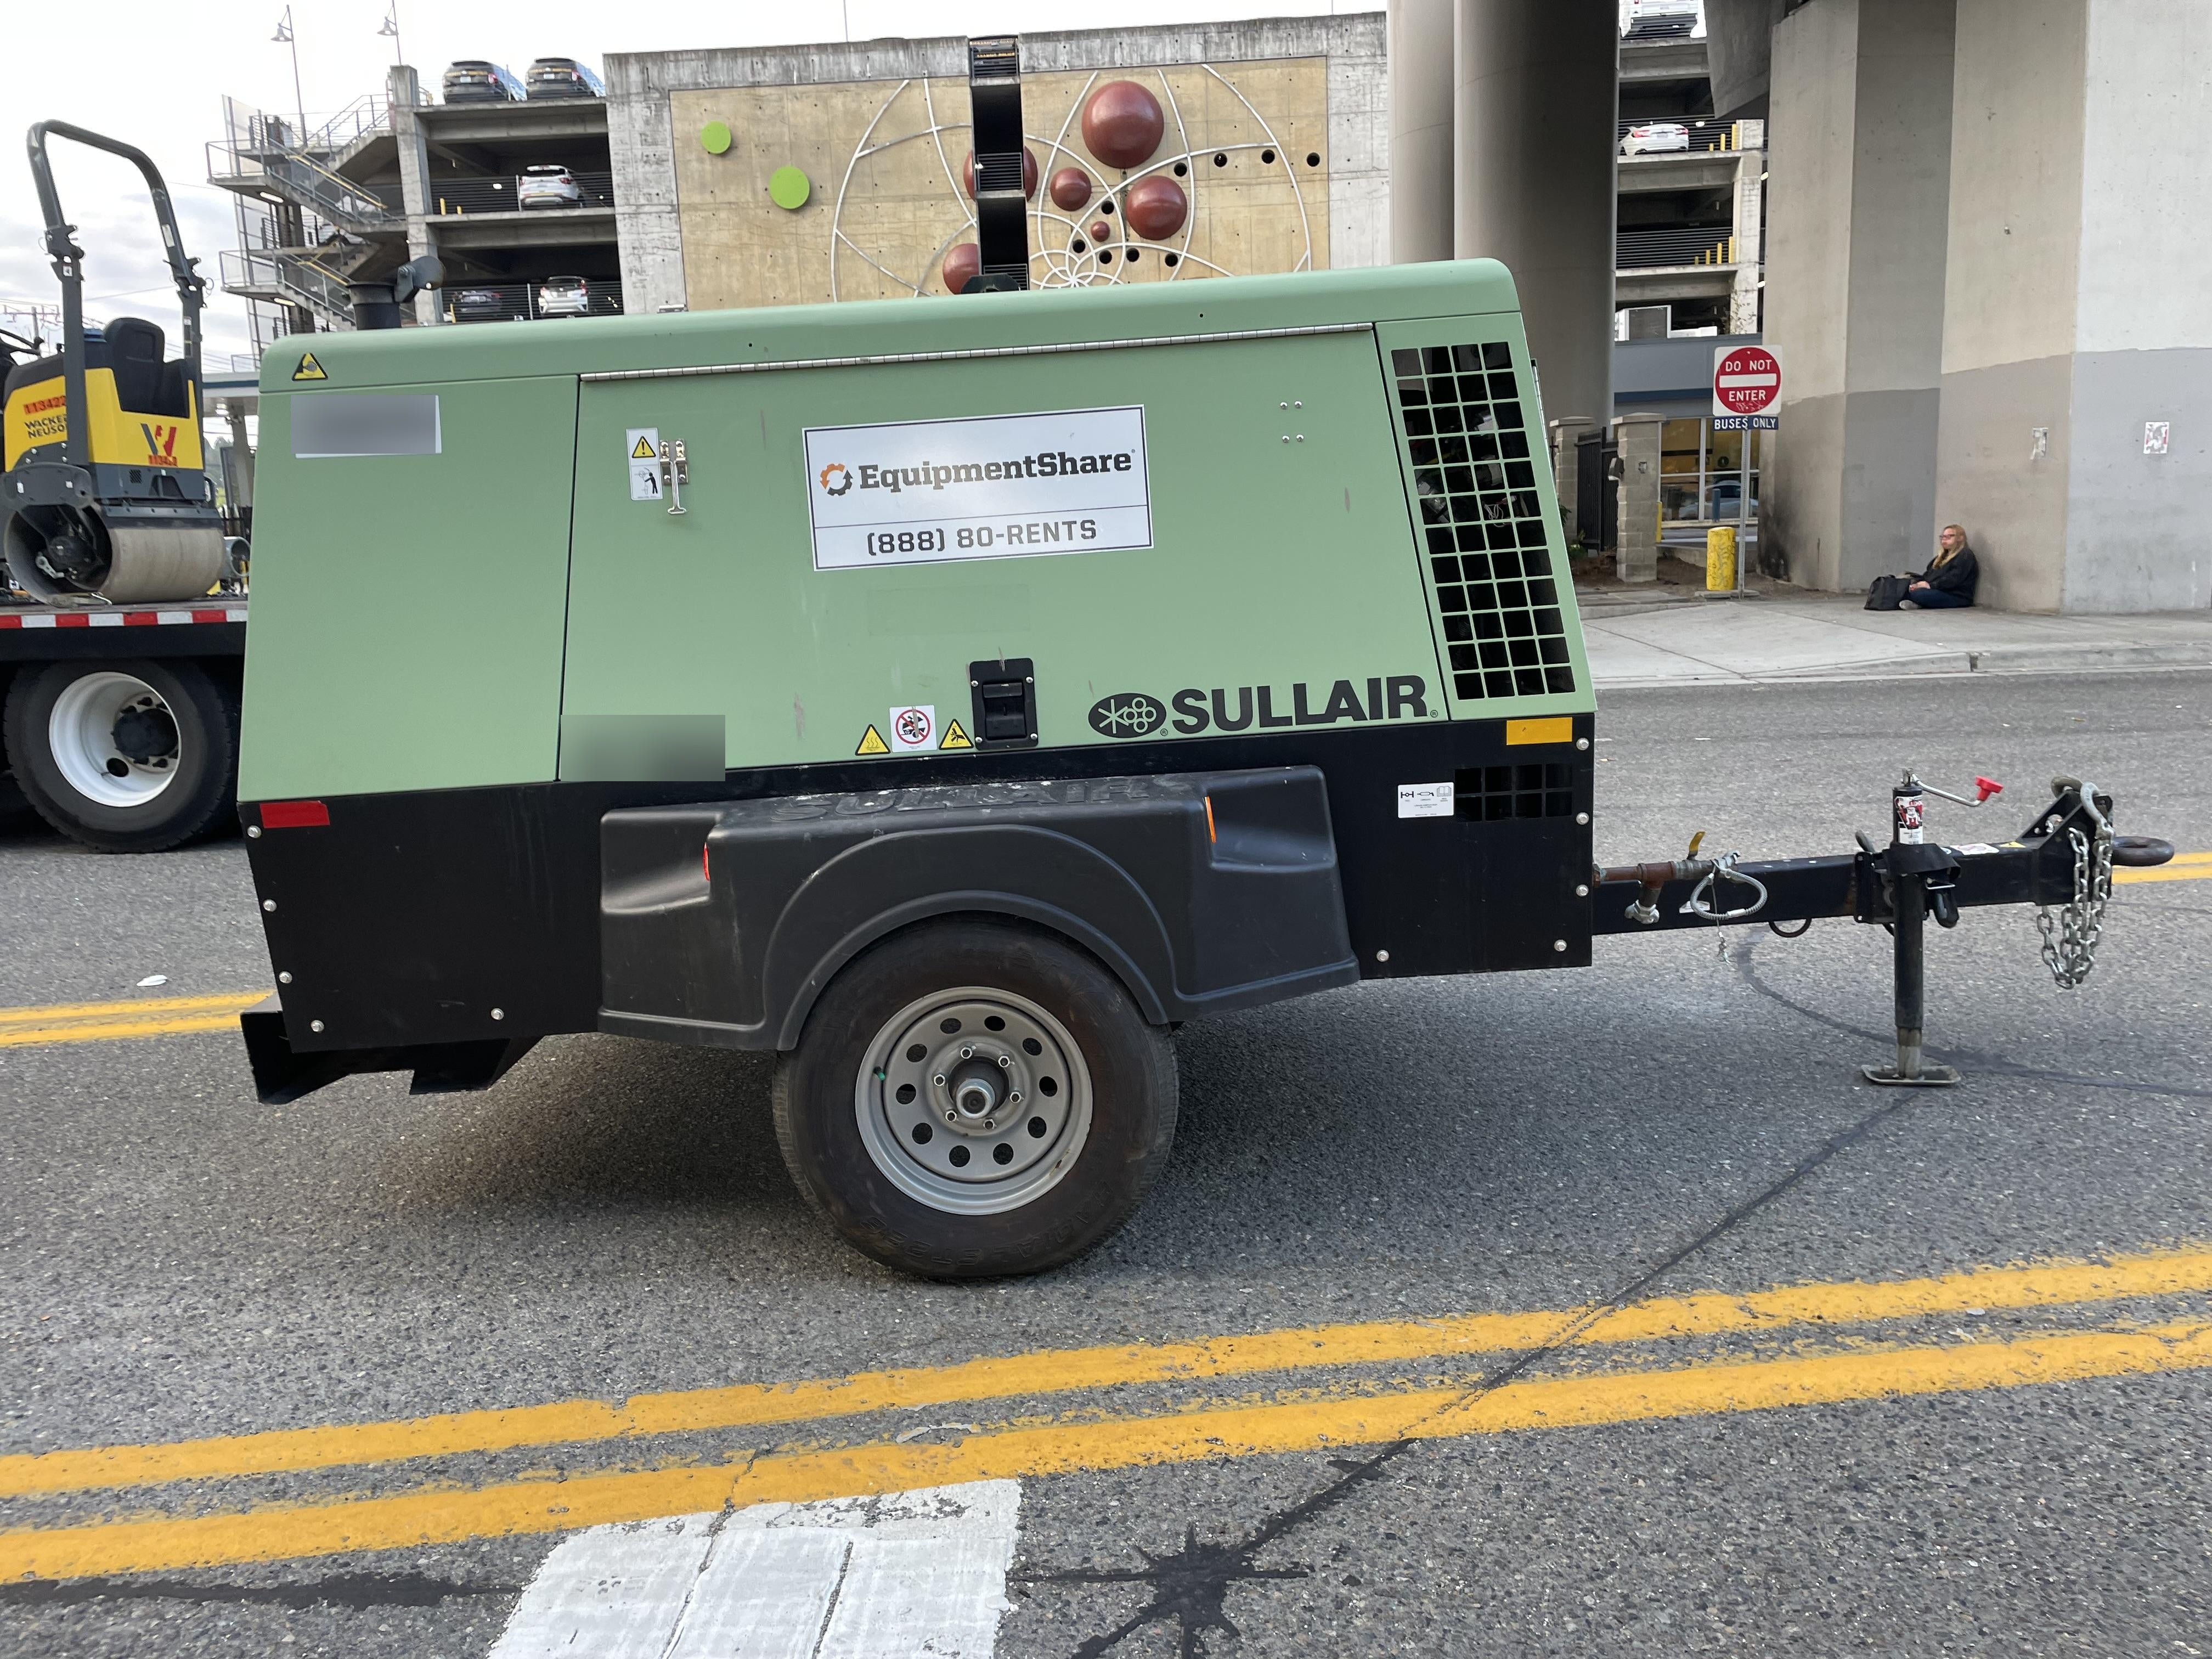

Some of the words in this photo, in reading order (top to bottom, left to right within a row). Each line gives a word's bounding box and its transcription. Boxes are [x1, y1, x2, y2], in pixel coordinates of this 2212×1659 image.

[1725, 360, 1742, 372] DO
[1749, 359, 1772, 371] NOT
[1728, 390, 1766, 402] ENTER
[27, 424, 65, 439] NEUSO
[1714, 417, 1748, 430] BUSES
[1752, 417, 1776, 428] ONLY
[858, 451, 1132, 493] EquipmentShare
[866, 528, 946, 557] (888)
[956, 518, 1097, 549] 80-RENTS
[1171, 674, 1428, 734] SULLAIR
[770, 780, 1150, 821] SULLAIR
